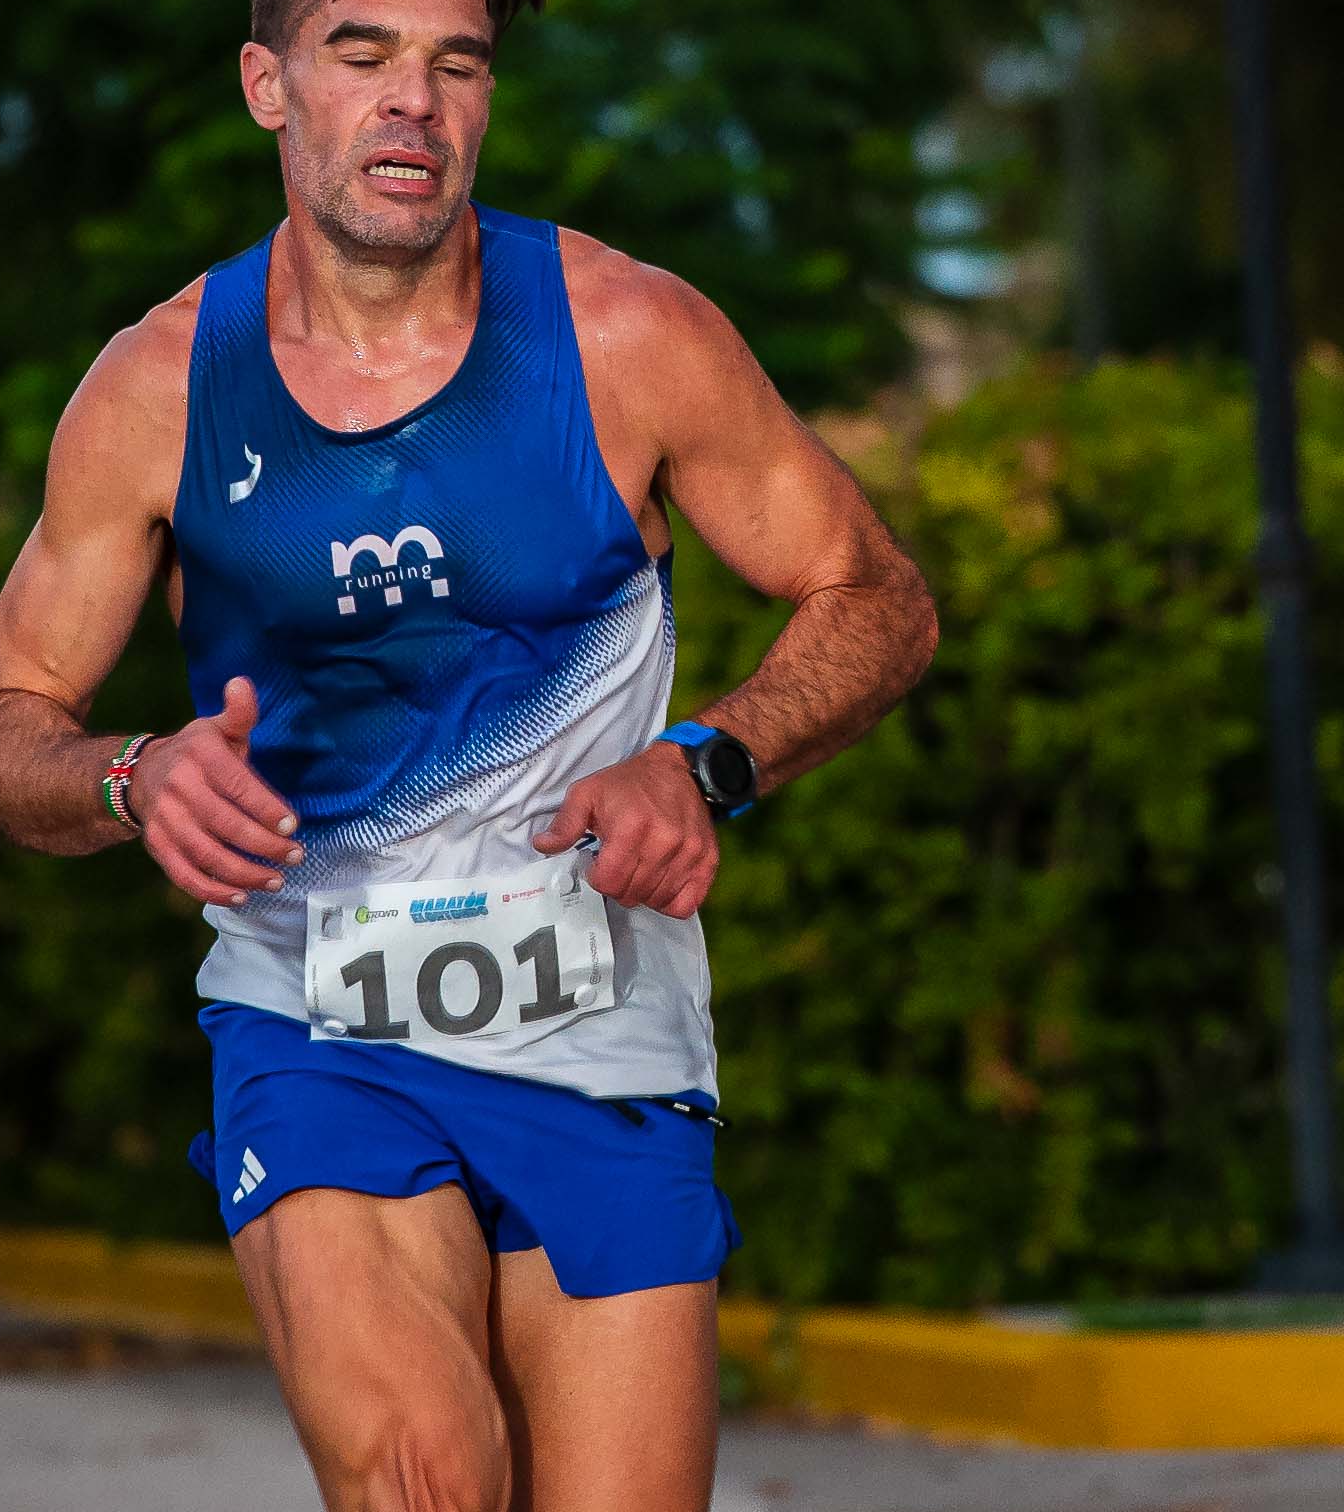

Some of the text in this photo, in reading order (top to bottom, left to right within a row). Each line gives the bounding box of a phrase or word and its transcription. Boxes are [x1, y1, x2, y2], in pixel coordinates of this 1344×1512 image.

[345, 564, 431, 592] running
[409, 890, 488, 914] MARATÓN
[340, 925, 581, 1040] 101
